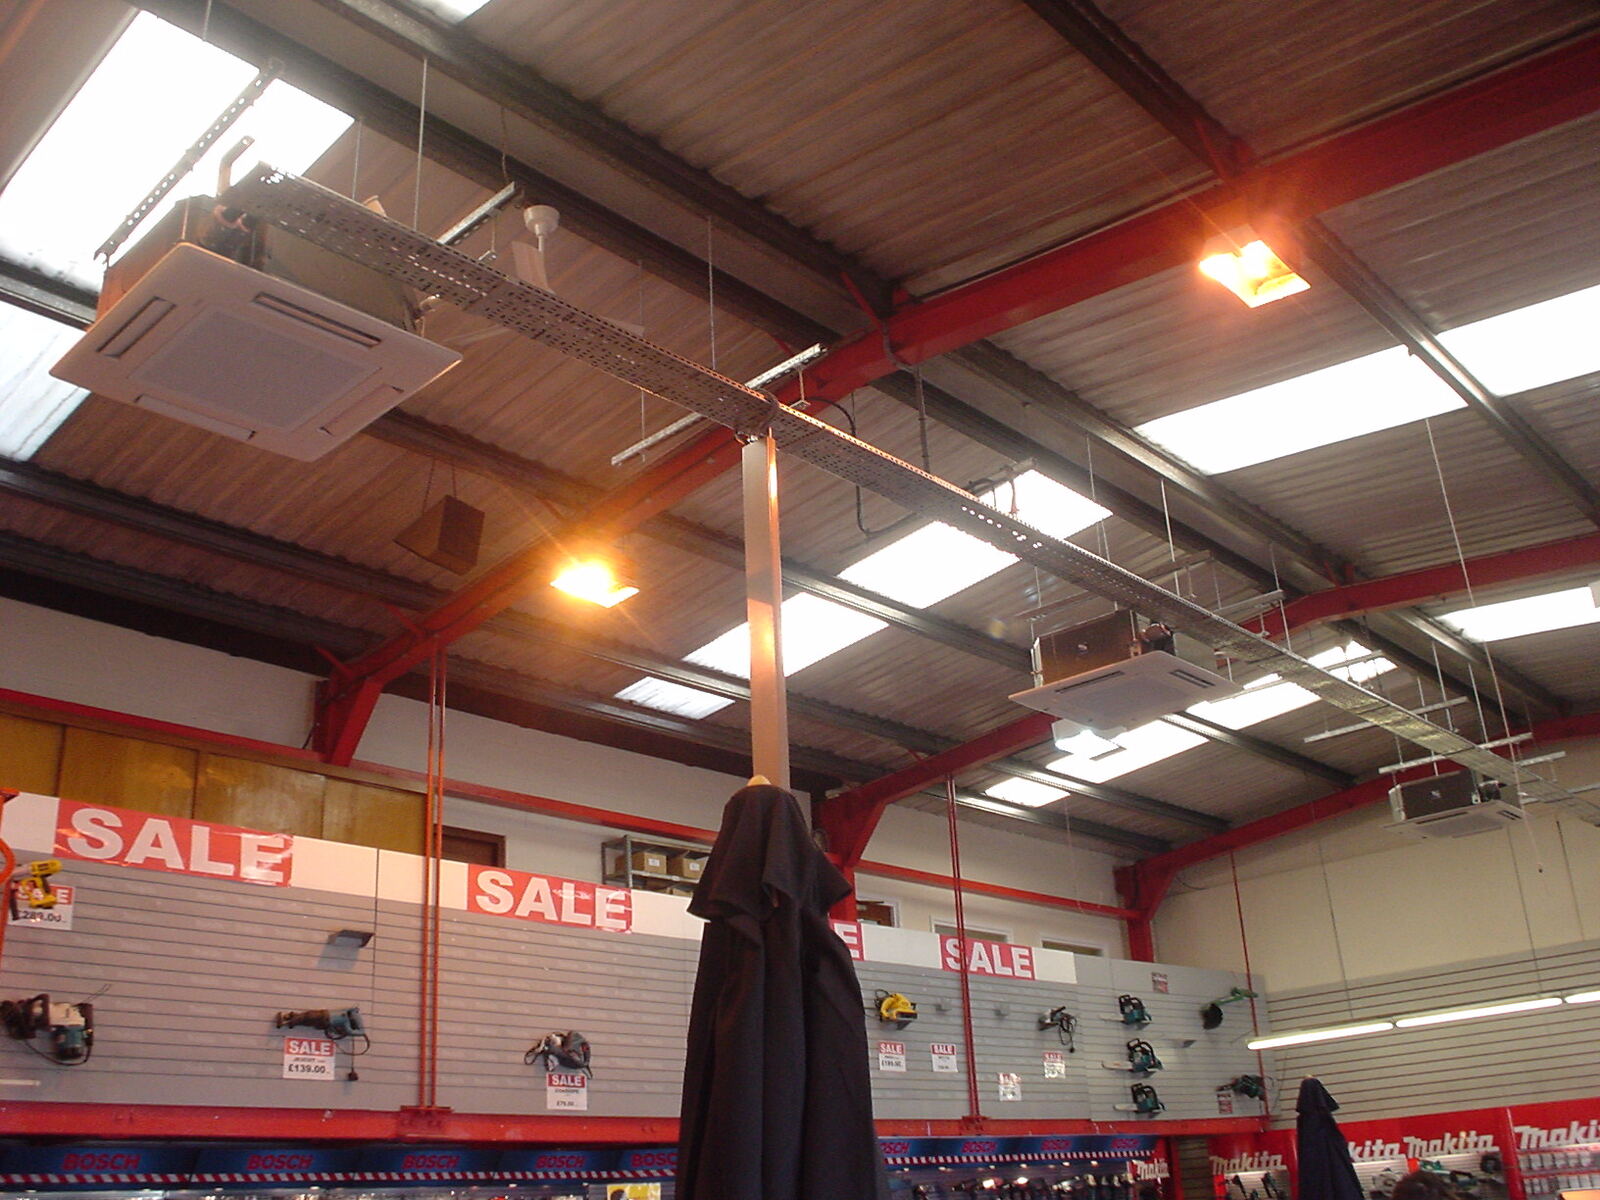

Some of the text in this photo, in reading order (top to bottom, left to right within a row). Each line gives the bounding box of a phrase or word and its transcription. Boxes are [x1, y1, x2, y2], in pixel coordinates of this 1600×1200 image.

[67, 807, 286, 883] SALE
[475, 870, 628, 930] SALE
[945, 938, 1033, 979] SALE
[289, 1040, 331, 1056] SALE
[880, 1043, 902, 1054] SALE
[551, 1074, 582, 1087] SALE
[962, 1141, 998, 1154] BOSCH
[1041, 1139, 1073, 1152] BOSCH
[61, 1153, 142, 1171] BOSCH
[247, 1154, 314, 1170] BOSCH
[402, 1154, 460, 1170] BOSCH
[535, 1154, 587, 1169] BOSCH
[631, 1152, 677, 1168] BOSC
